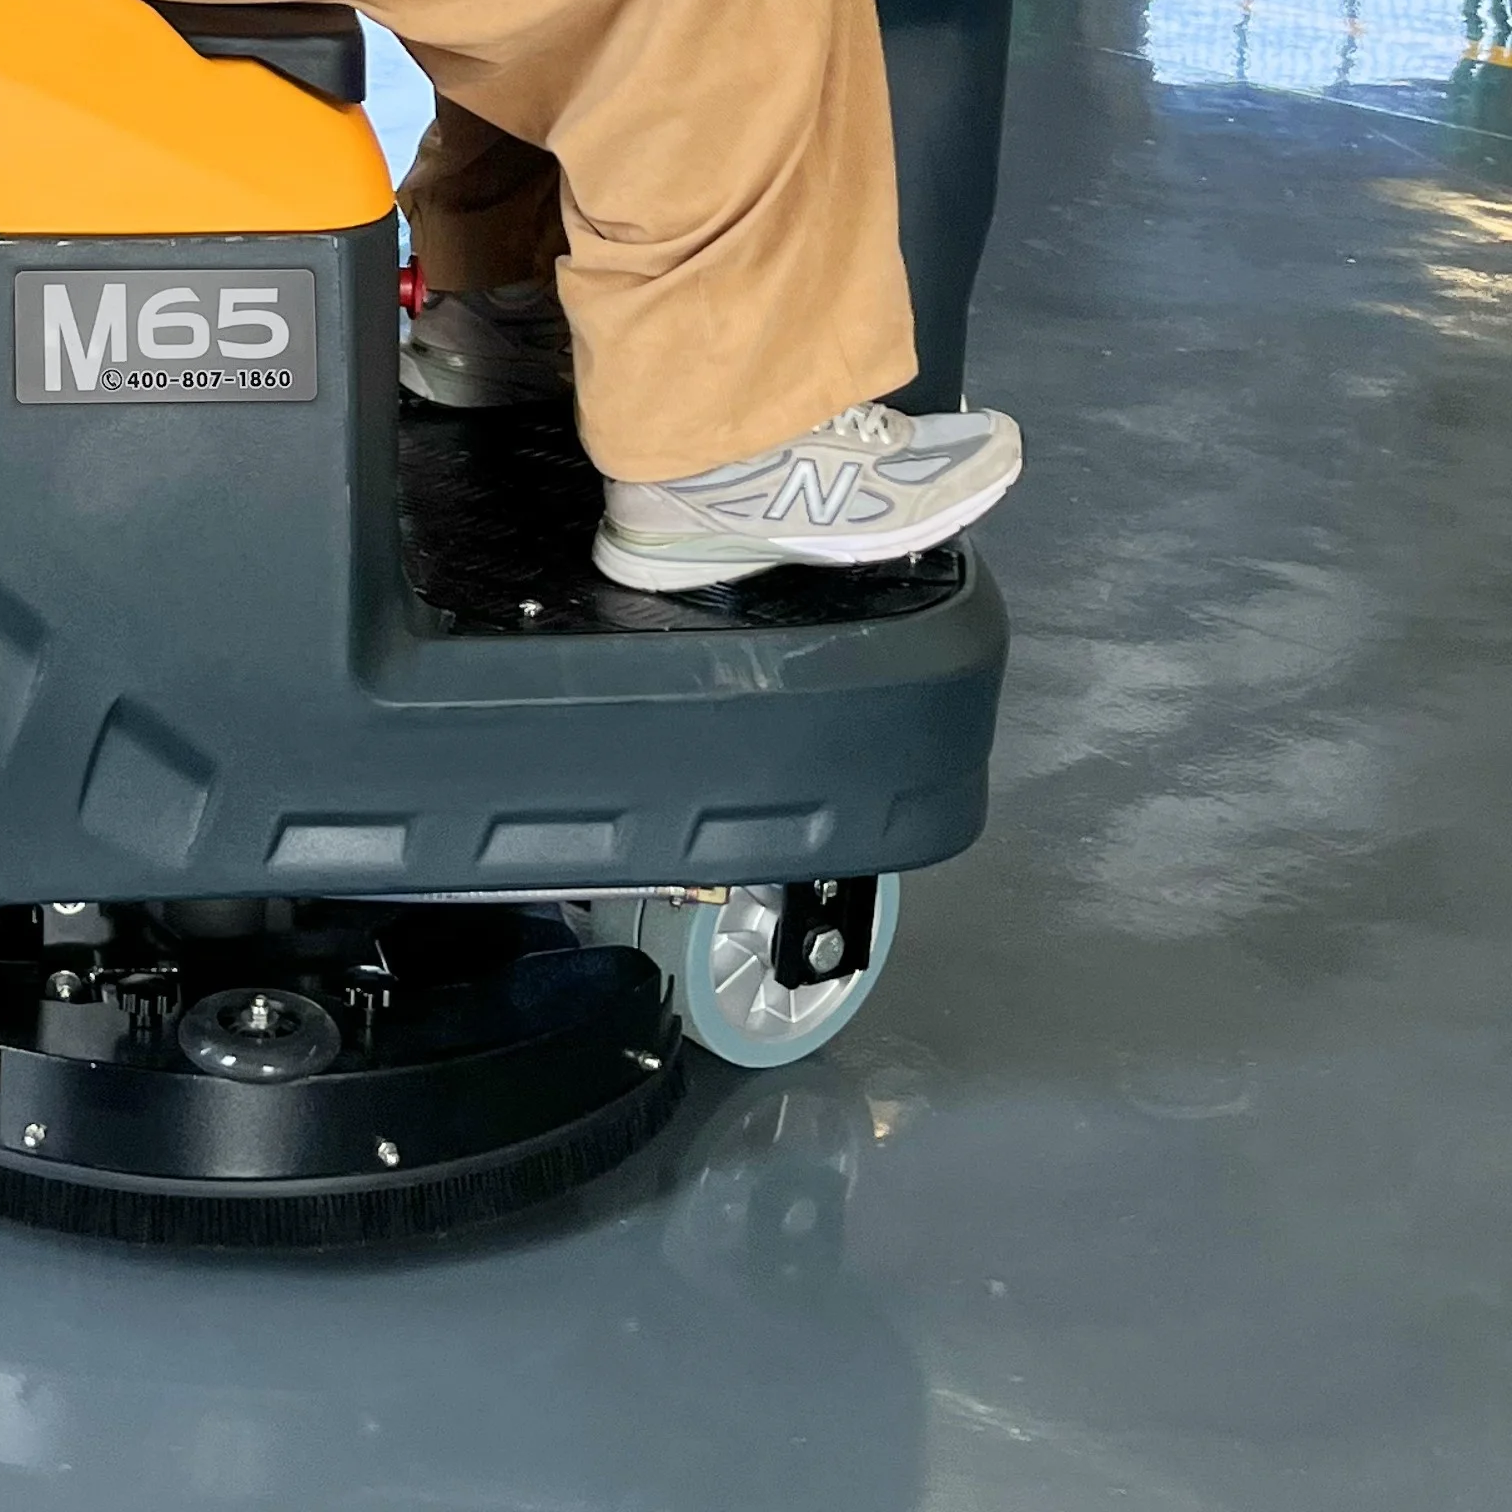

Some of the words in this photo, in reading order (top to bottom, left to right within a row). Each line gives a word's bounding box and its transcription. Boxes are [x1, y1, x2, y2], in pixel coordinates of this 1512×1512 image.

[43, 283, 289, 391] M65
[127, 370, 291, 389] 400-807-1860
[763, 458, 861, 525] N
